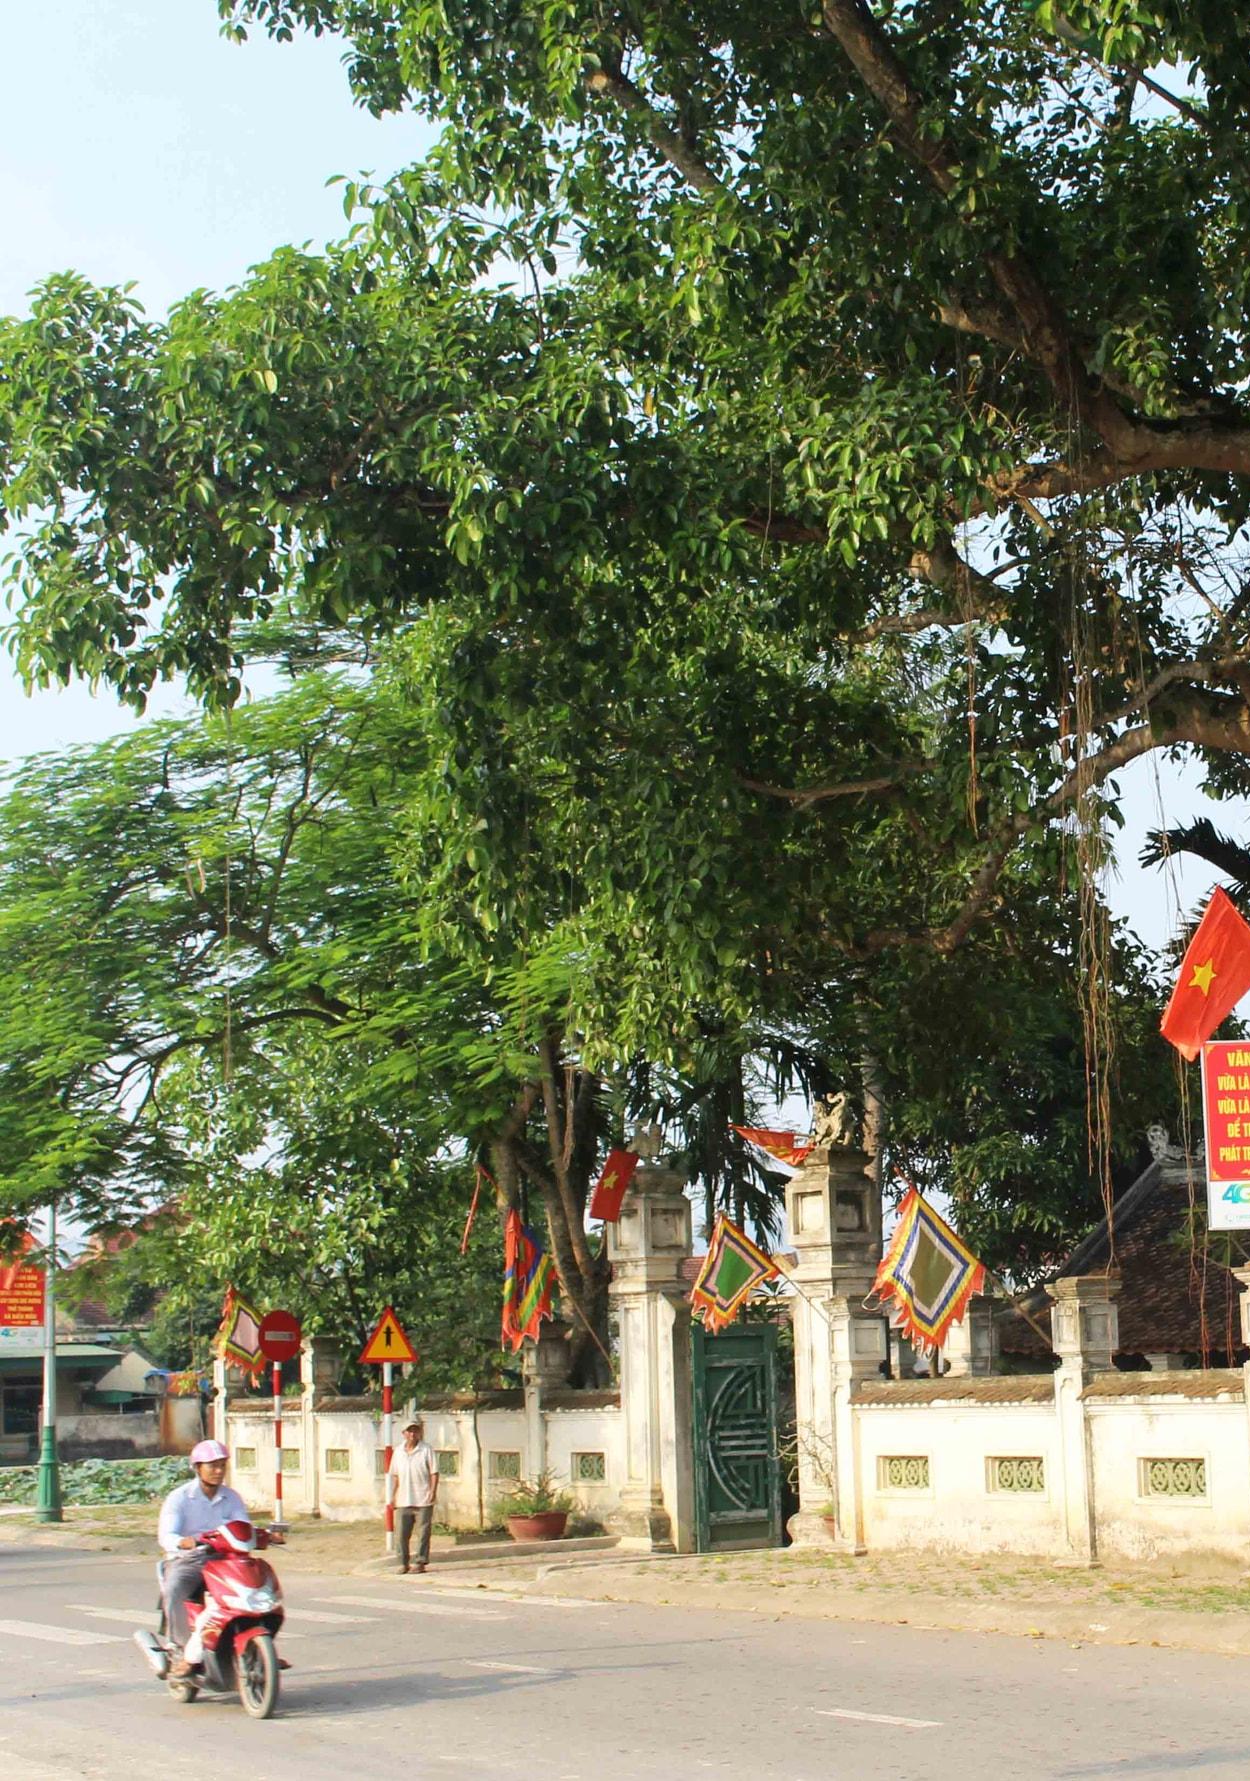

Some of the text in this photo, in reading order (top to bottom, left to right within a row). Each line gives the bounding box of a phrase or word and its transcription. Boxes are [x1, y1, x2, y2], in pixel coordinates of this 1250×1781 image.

[1218, 1073, 1237, 1091] VỪA
[1238, 1072, 1250, 1091] LÀ
[1218, 1096, 1237, 1114] VỪA
[1238, 1096, 1250, 1114] LÀ
[1219, 1144, 1241, 1162] PHÁT
